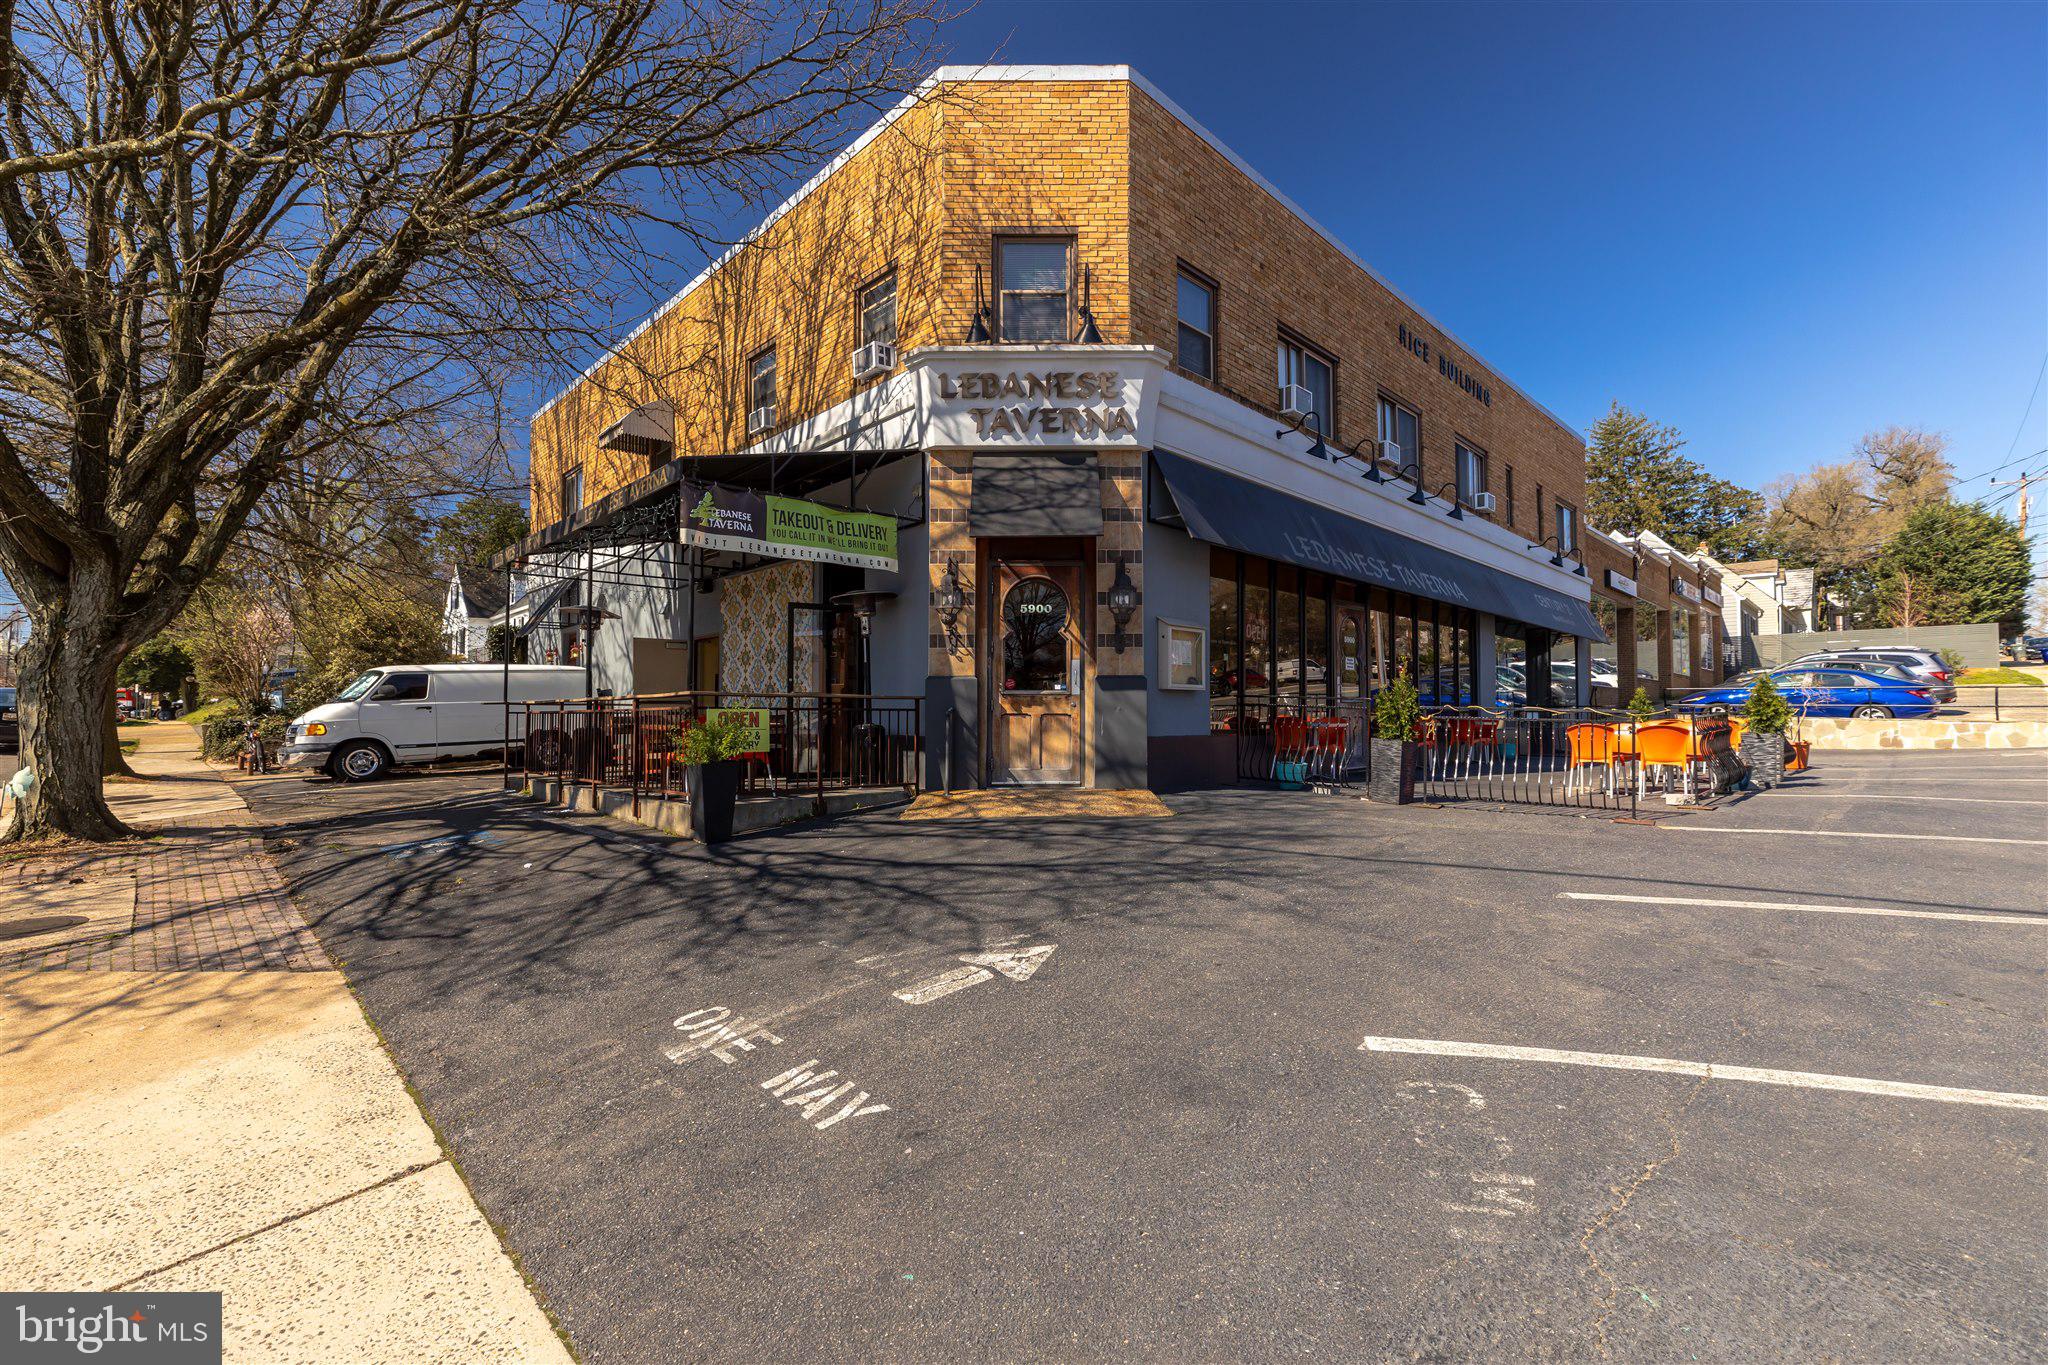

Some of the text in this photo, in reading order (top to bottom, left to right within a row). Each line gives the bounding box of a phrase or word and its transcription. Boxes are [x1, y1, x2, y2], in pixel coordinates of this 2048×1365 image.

[1399, 324, 1491, 408] RICE BUILDING
[938, 371, 1120, 400] LEBANESE
[967, 406, 1137, 435] TAVERNA
[708, 518, 753, 533] TAVERNA
[771, 528, 787, 539] YOU
[788, 530, 807, 541] CALL
[808, 532, 815, 542] IT
[818, 534, 826, 542] IN
[827, 535, 846, 548] WE'LL
[848, 539, 868, 550] BRING
[869, 542, 876, 551] IT
[772, 508, 888, 542] TAKEOUT & DELIVERY
[691, 534, 727, 548] VISIT
[1283, 532, 1469, 602] LEBANESE TAVERNA
[1020, 604, 1053, 614] 5900
[717, 711, 760, 729] OPEN
[664, 1006, 784, 1065] ONE
[760, 1058, 891, 1131] WAY
